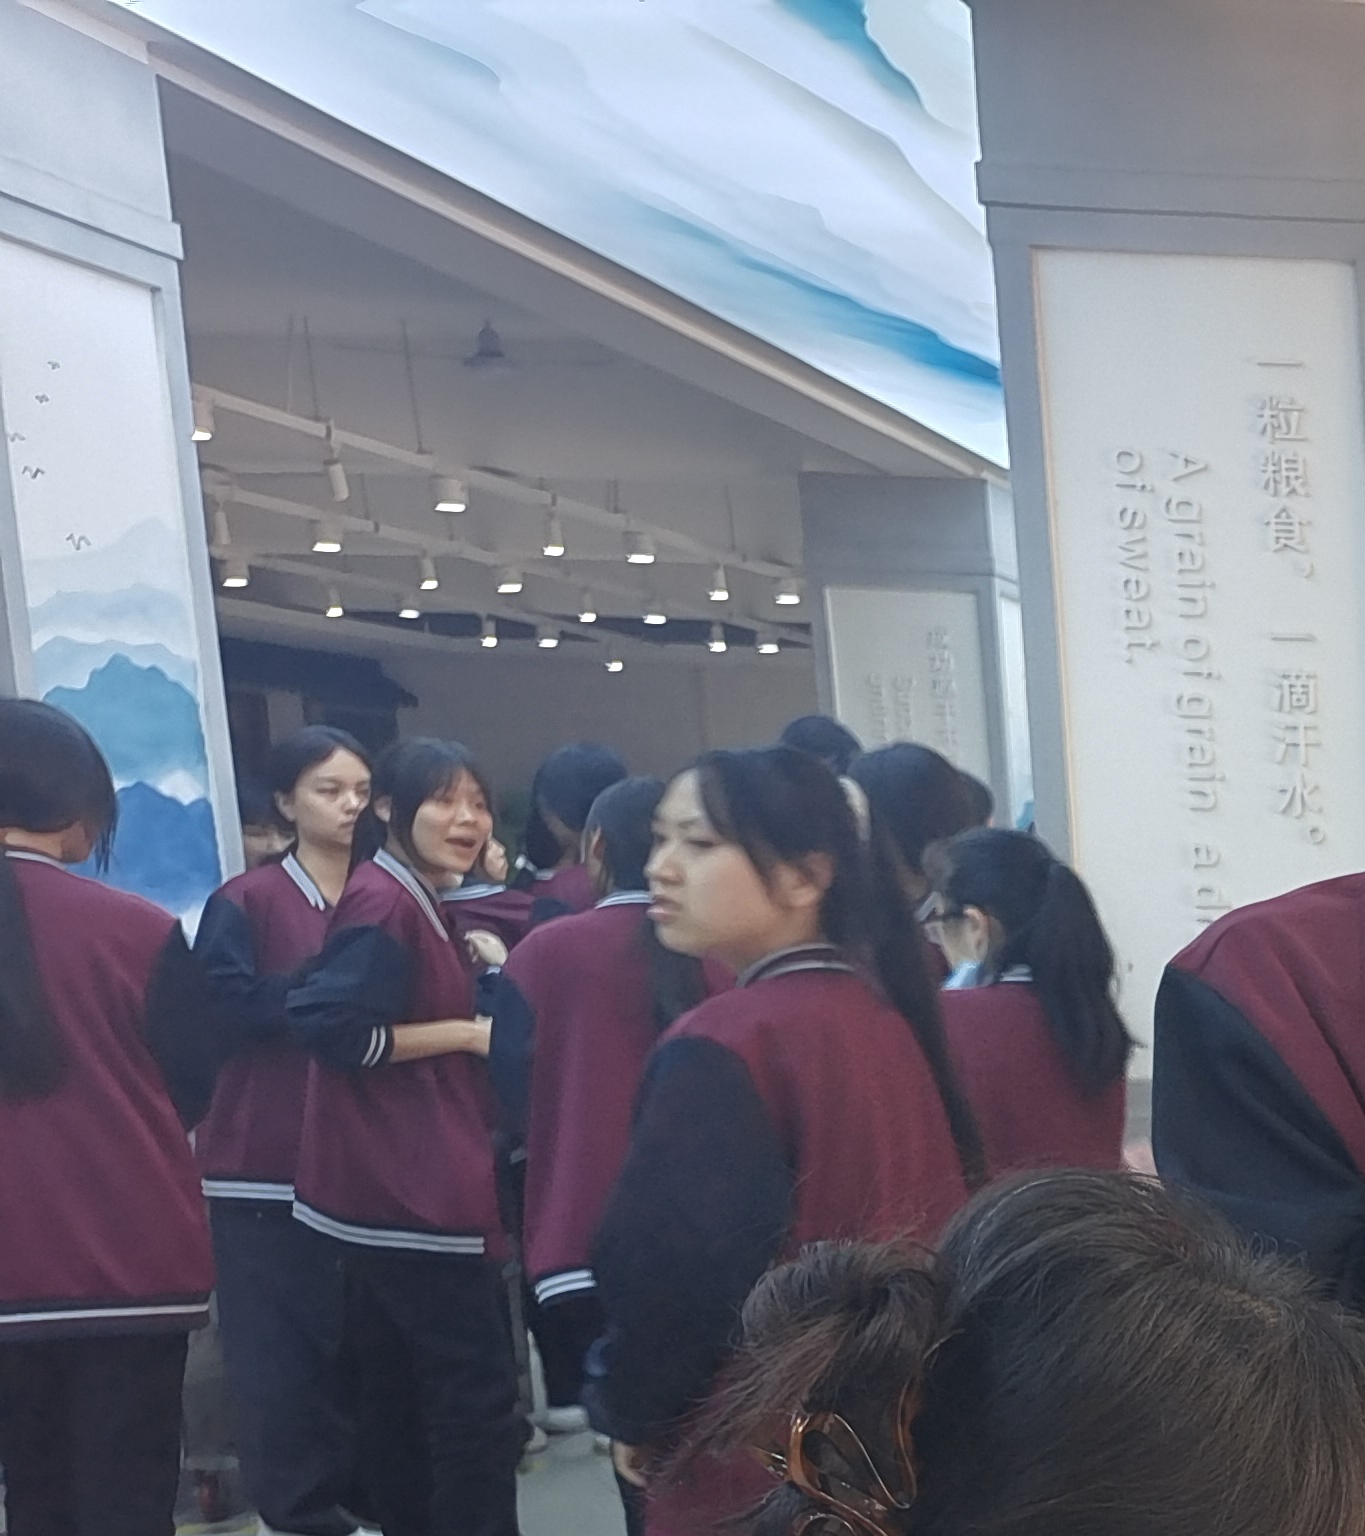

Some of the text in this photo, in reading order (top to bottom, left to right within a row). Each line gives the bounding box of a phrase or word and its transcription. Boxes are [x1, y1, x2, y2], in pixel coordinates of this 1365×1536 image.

[1167, 451, 1210, 483] A
[1114, 450, 1161, 666] of sweat.
[1163, 498, 1217, 620] grain
[1181, 638, 1223, 682] of
[1176, 693, 1227, 812] grain
[1193, 846, 1221, 869] a
